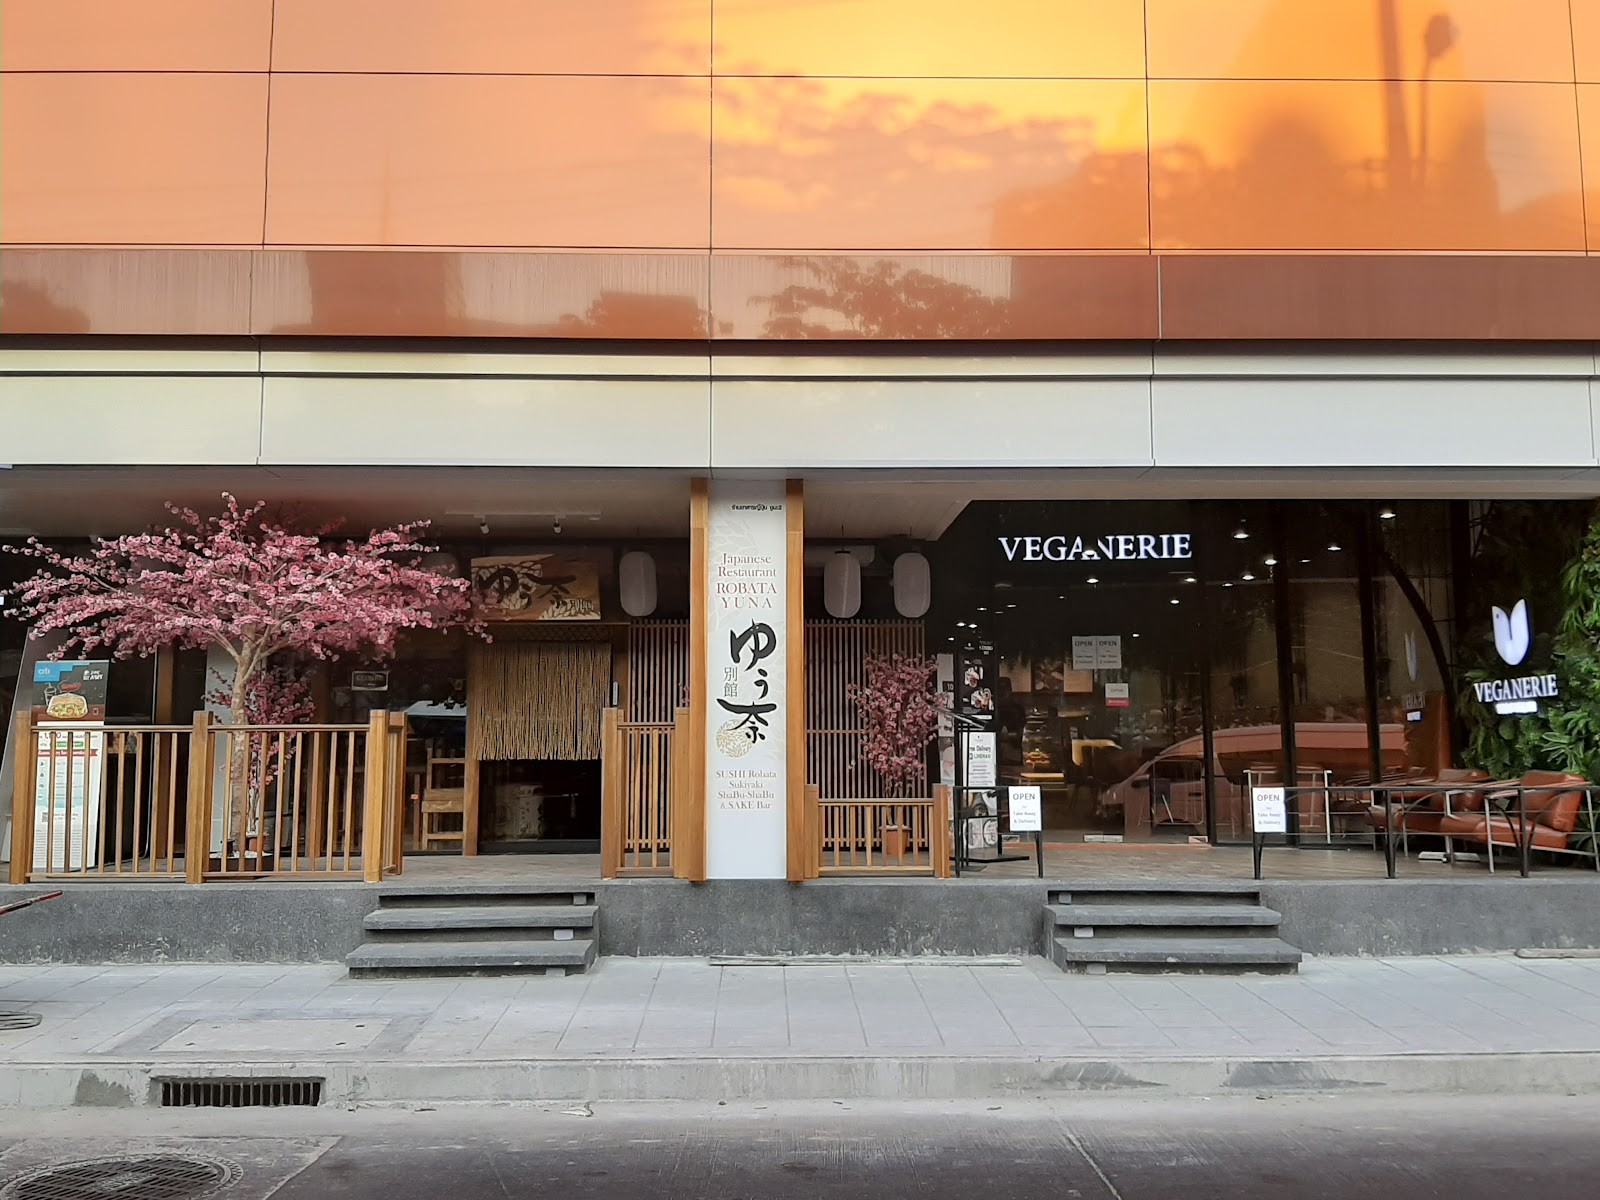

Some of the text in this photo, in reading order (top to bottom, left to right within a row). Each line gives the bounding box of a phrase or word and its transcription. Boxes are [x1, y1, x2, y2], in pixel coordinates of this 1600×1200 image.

[998, 534, 1192, 562] VEGANERIE
[721, 553, 772, 566] Japanese
[718, 566, 776, 577] Restaurant
[717, 582, 777, 594] ROBATA
[721, 597, 772, 609] YUNA
[723, 666, 738, 698] 別館
[1473, 674, 1558, 702] VEGANERIE
[716, 770, 777, 778] SUSHI Robata
[729, 780, 764, 789] Sukiyaki
[1012, 793, 1036, 801] OPEN
[728, 801, 755, 809] SAKE
[756, 801, 772, 809] Bar
